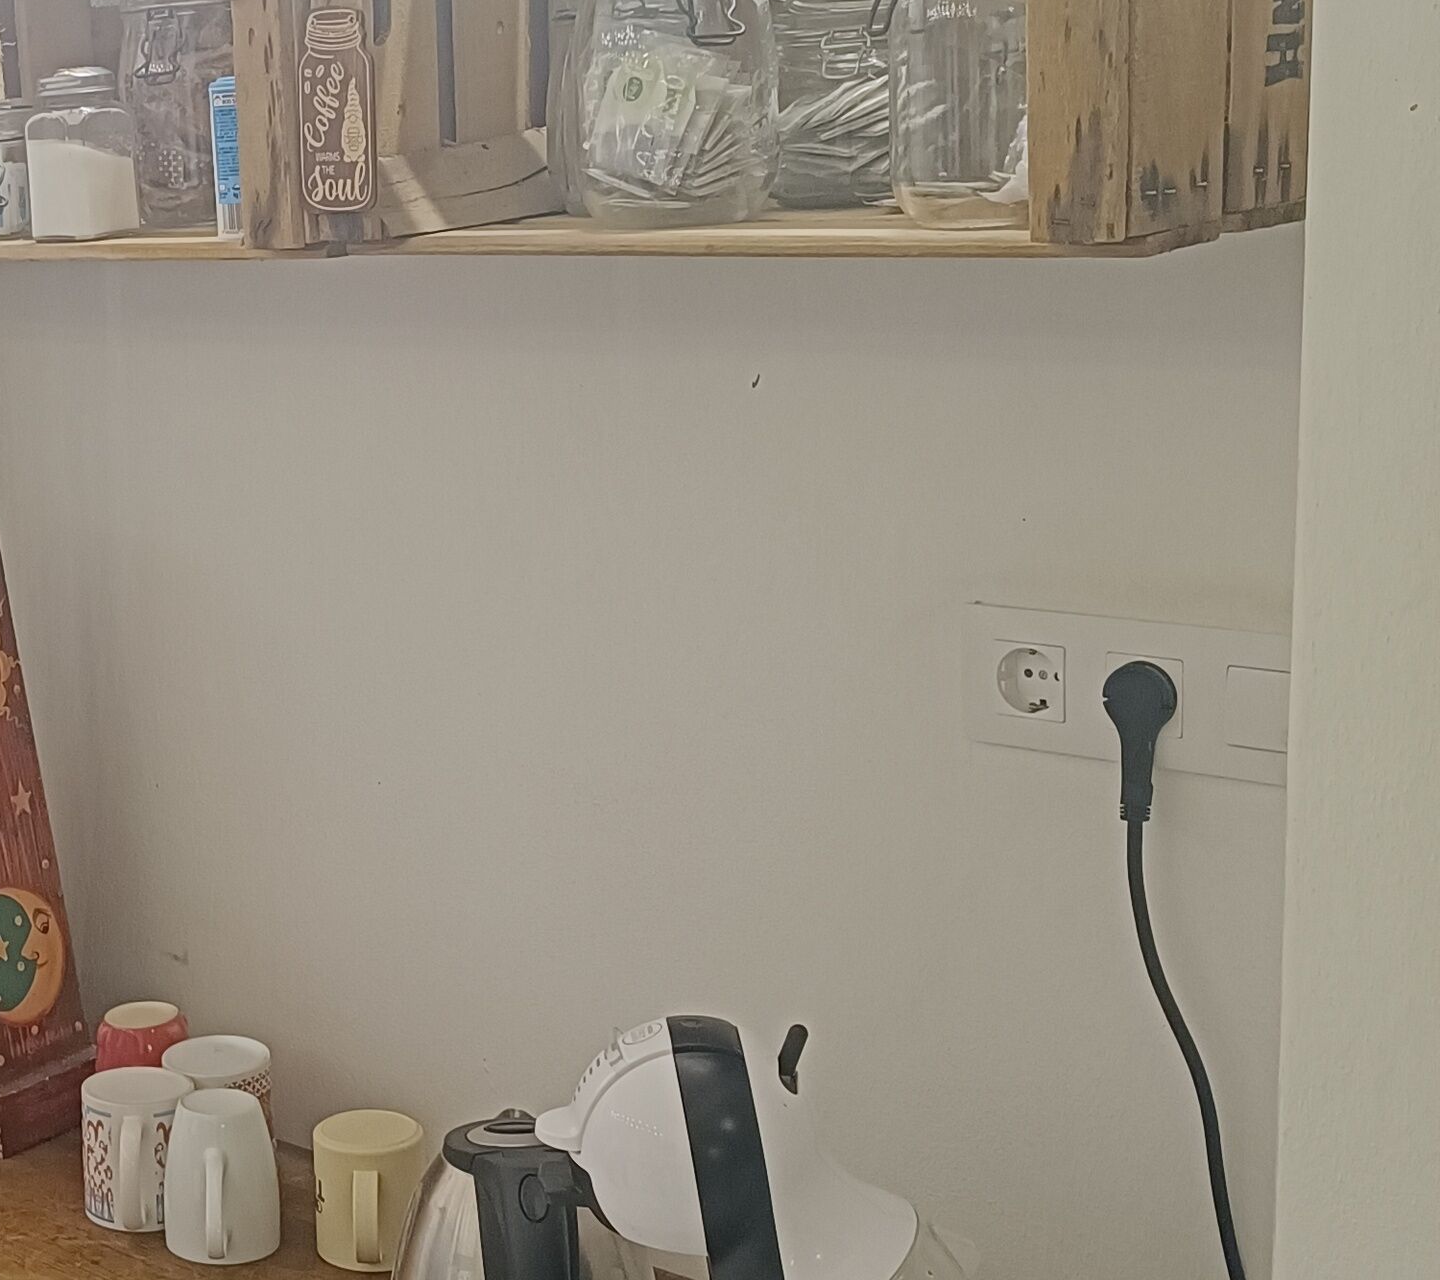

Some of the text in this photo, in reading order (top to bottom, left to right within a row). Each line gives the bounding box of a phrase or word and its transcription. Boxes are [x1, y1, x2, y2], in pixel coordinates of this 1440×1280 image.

[303, 61, 345, 153] Coffee
[315, 151, 341, 162] WARMS
[307, 161, 368, 203] Soul
[321, 165, 335, 176] THE
